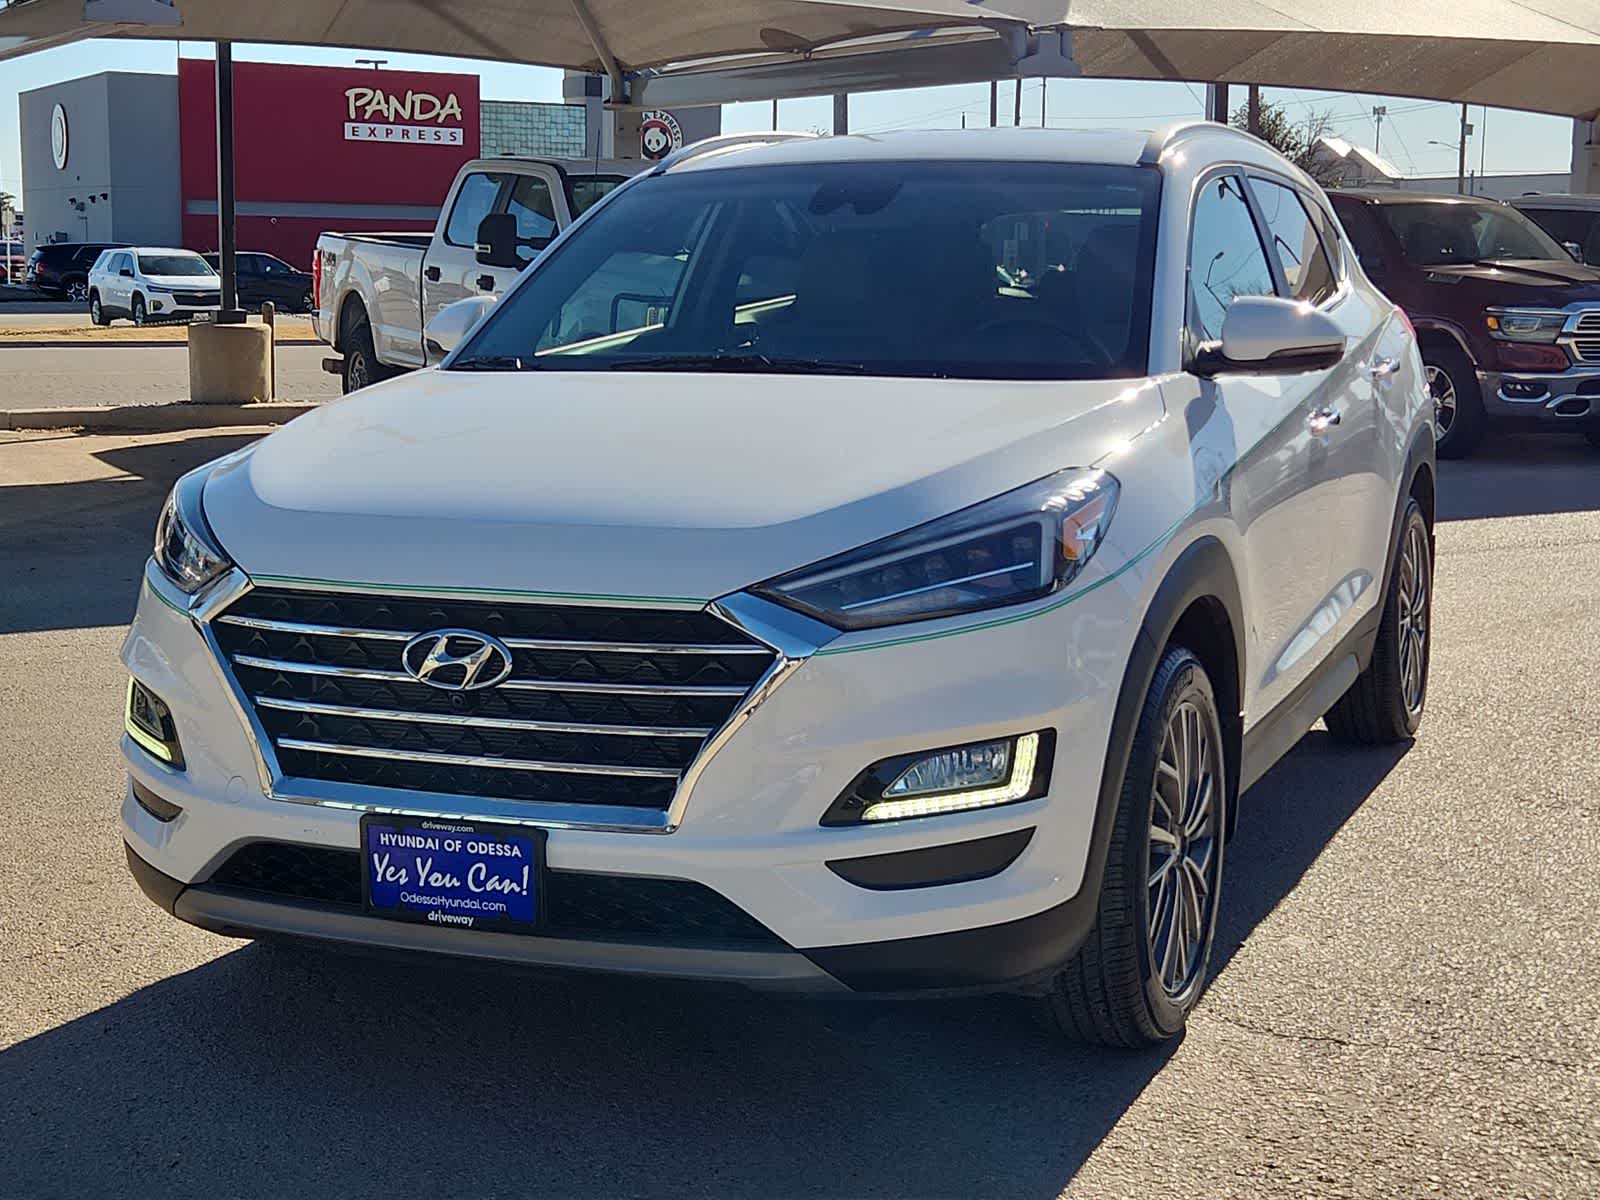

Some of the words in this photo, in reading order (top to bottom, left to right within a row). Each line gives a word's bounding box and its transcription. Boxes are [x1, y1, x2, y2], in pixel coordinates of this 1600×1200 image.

[345, 87, 462, 123] PANDA
[351, 126, 457, 142] EXPRESS
[654, 110, 681, 142] EXPRESS
[421, 821, 474, 832] driveway.com
[380, 833, 439, 850] HYUNDAI
[444, 839, 462, 852] OF
[467, 841, 522, 858] ODESSA
[372, 853, 409, 885] Yes
[415, 857, 460, 887] You
[467, 862, 529, 895] Can!
[400, 891, 507, 911] OdessaHyundai.com
[428, 909, 474, 927] driveway
